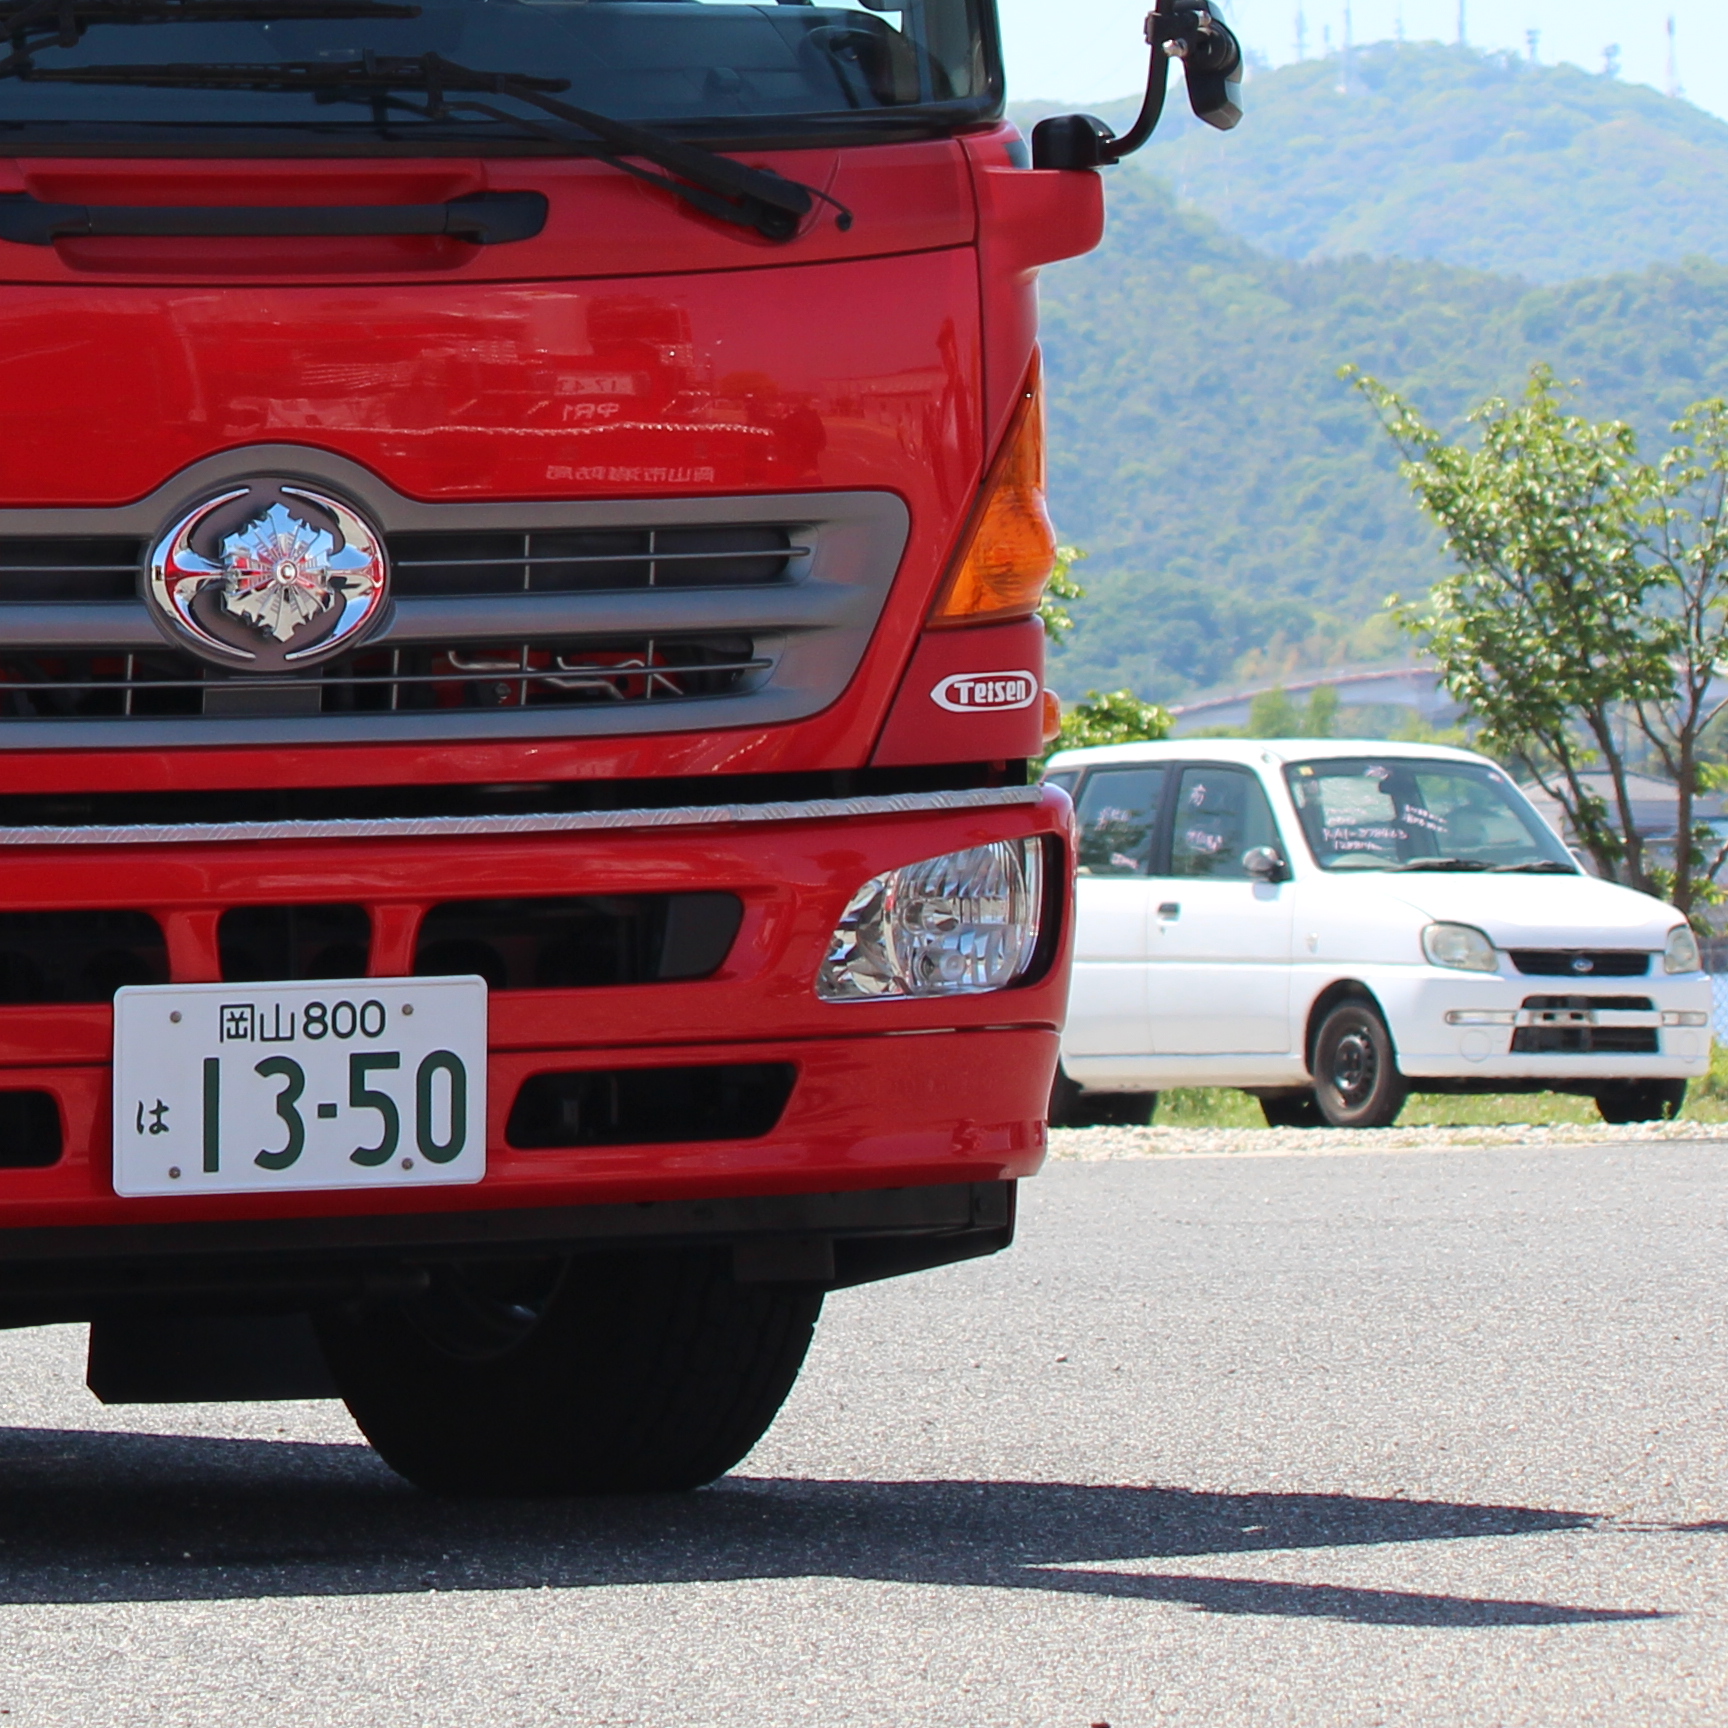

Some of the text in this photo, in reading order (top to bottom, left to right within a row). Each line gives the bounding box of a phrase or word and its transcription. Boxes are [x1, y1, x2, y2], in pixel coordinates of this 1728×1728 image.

[953, 679, 1027, 705] Teisen
[136, 1048, 468, 1174] は 13-50
